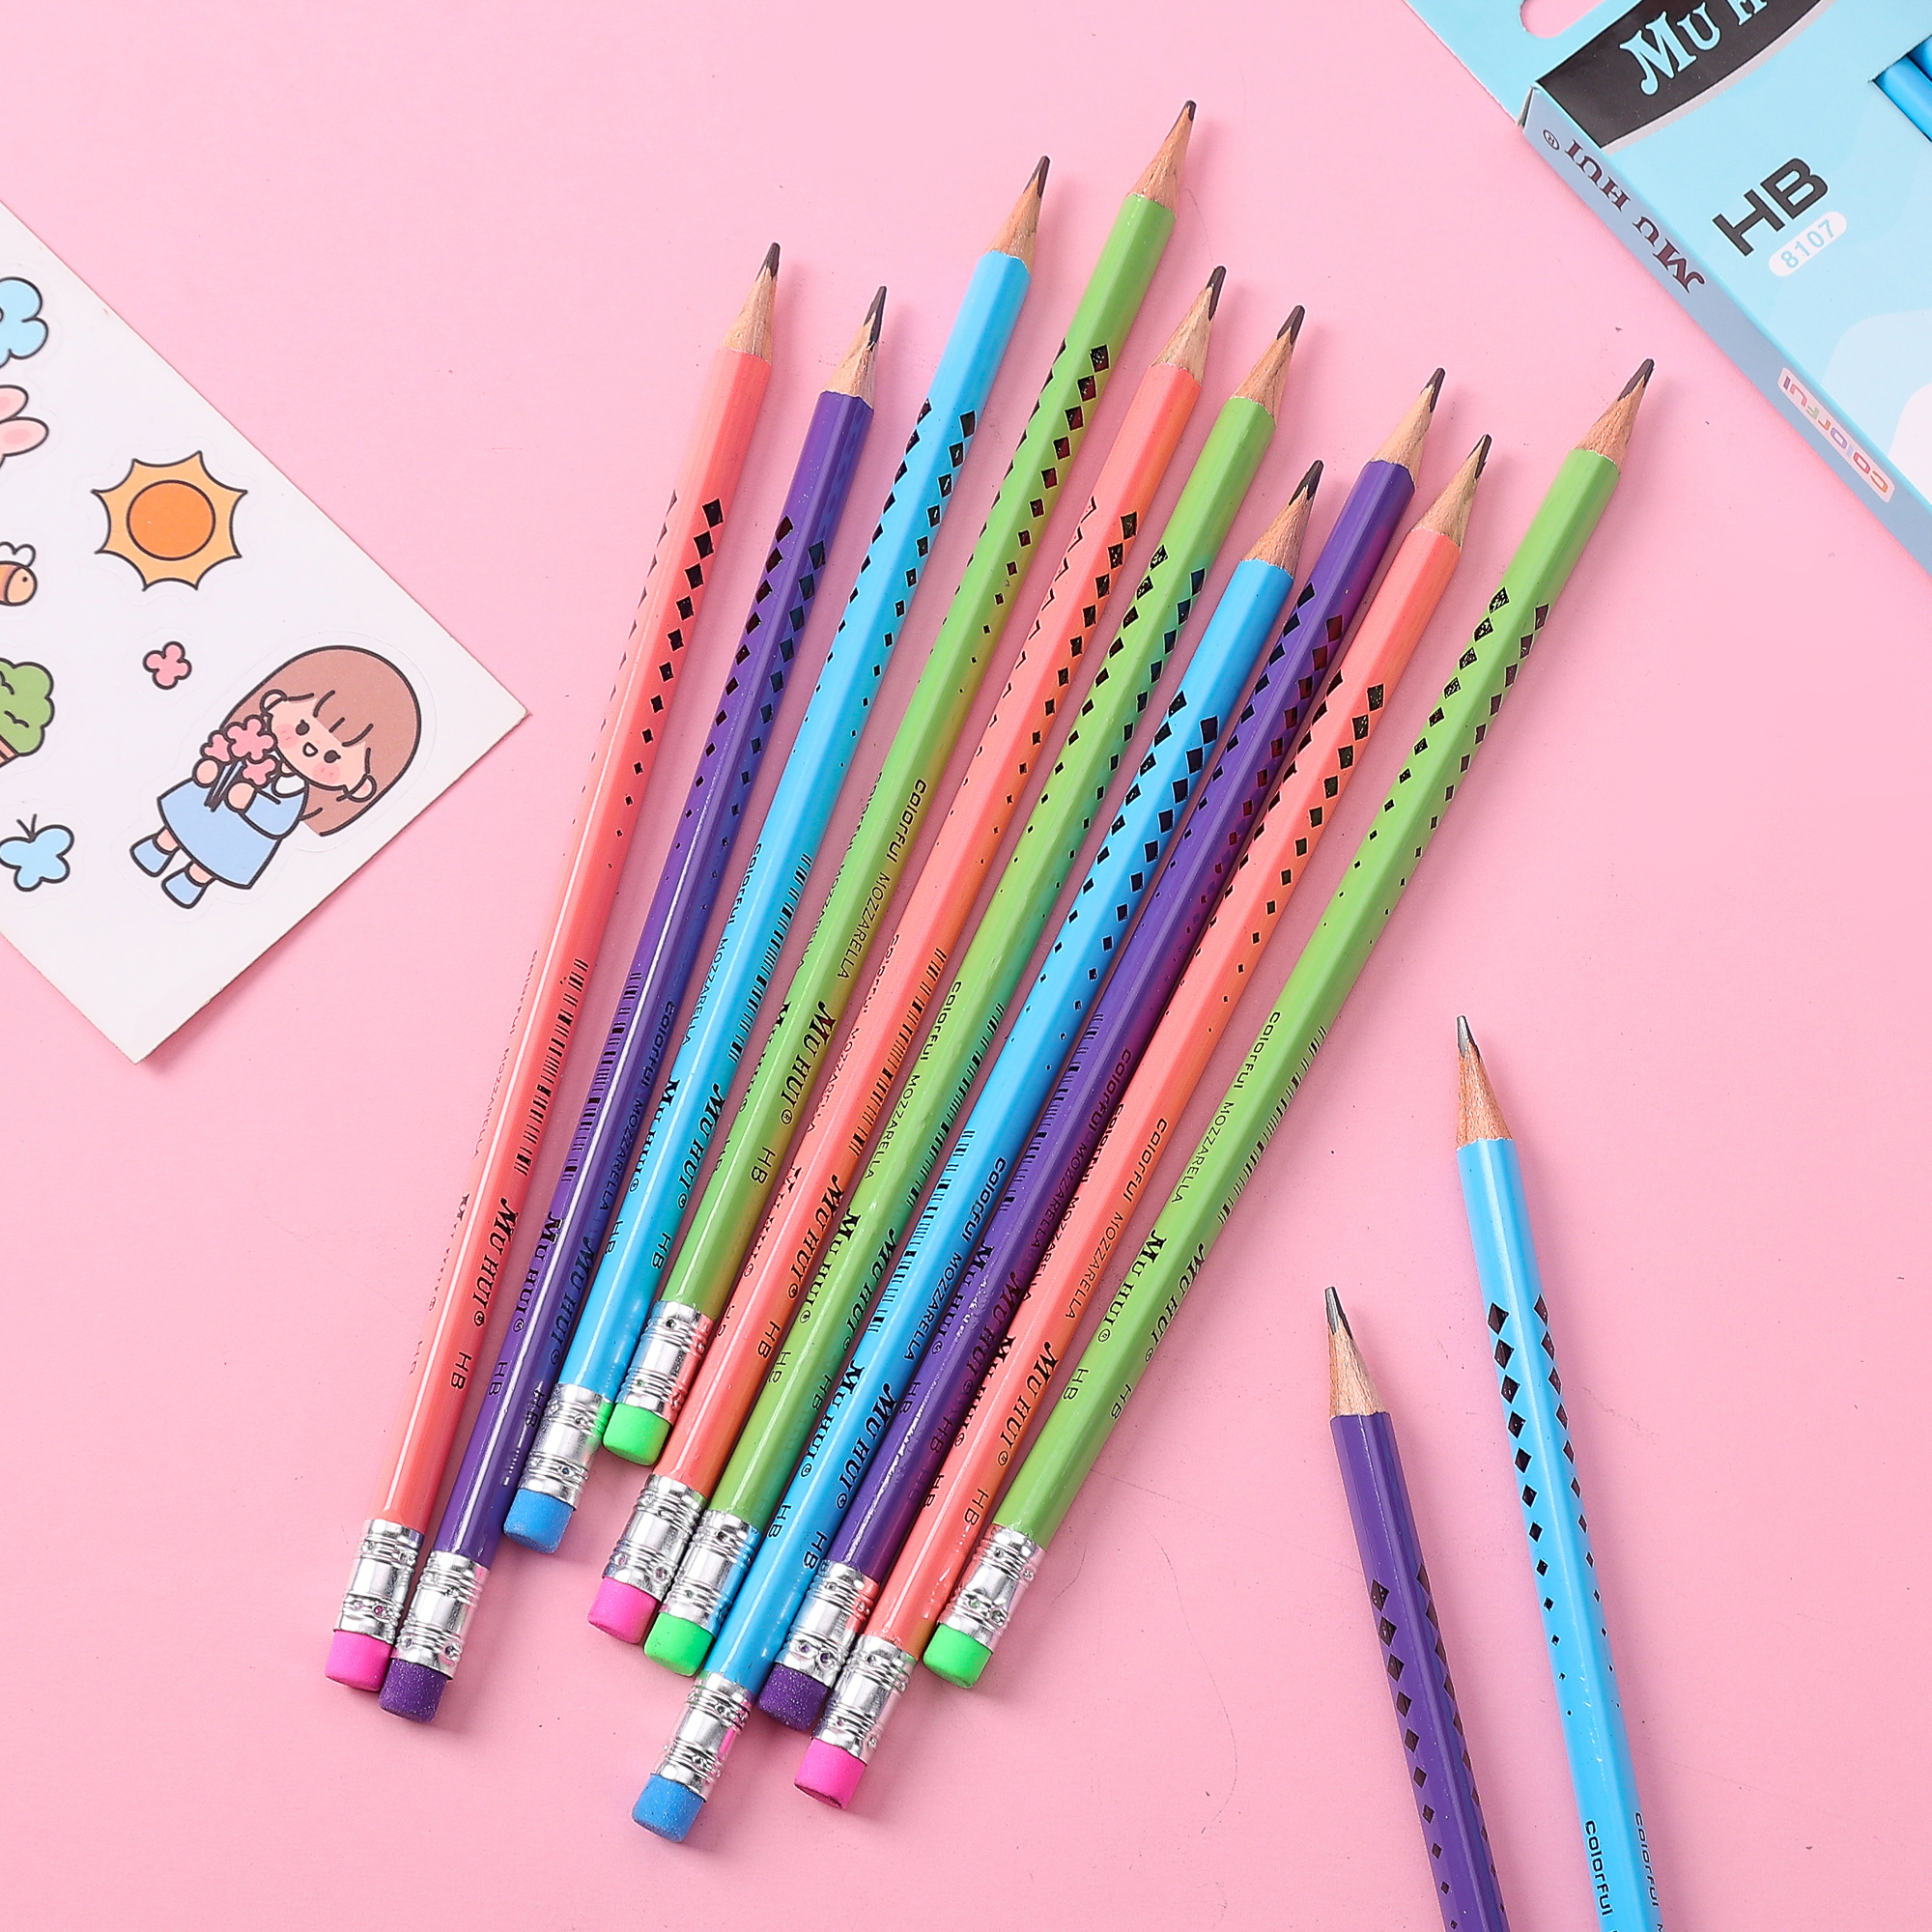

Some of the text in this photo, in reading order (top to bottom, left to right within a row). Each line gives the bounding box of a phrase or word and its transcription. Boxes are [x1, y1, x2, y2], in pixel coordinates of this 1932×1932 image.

[1619, 1, 1721, 97] MU
[1712, 157, 1829, 256] HB
[1633, 215, 1706, 295] MU
[1780, 218, 1835, 270] 8107
[838, 872, 892, 979] MOZZARELLA
[682, 938, 728, 1045] MOZZARELLA
[803, 1001, 838, 1058] MU
[699, 1083, 725, 1140] MU
[865, 1074, 921, 1179] MOZZARELLA
[599, 1099, 642, 1211] MOZZARELLA
[751, 1147, 777, 1184] HB
[1171, 1100, 1235, 1204] MOZZARELLA
[815, 1175, 845, 1233] MU
[1030, 1142, 1088, 1248] MOZZARELLA
[488, 1197, 519, 1255] MU
[535, 1211, 563, 1261] MU
[604, 1220, 623, 1254] HB
[651, 1231, 673, 1270] HB
[871, 1229, 897, 1283] MU
[1065, 1211, 1125, 1320] MOZZARELLA
[1131, 1229, 1167, 1278] MU
[1179, 1242, 1206, 1297] MU
[904, 1252, 964, 1361] MOZZARELLA
[757, 1321, 781, 1359] HB
[450, 1351, 472, 1389] HB
[488, 1362, 508, 1396] HB
[812, 1374, 833, 1410] HB
[1026, 1341, 1059, 1398] MU
[1063, 1368, 1089, 1400] HB
[525, 1389, 546, 1428] HB
[865, 1382, 897, 1440] MU
[899, 1381, 922, 1414] HB
[1111, 1383, 1133, 1420] HB
[929, 1417, 954, 1454] HB
[767, 1504, 792, 1538] HB
[964, 1488, 989, 1526] HB
[803, 1530, 828, 1570] HB
